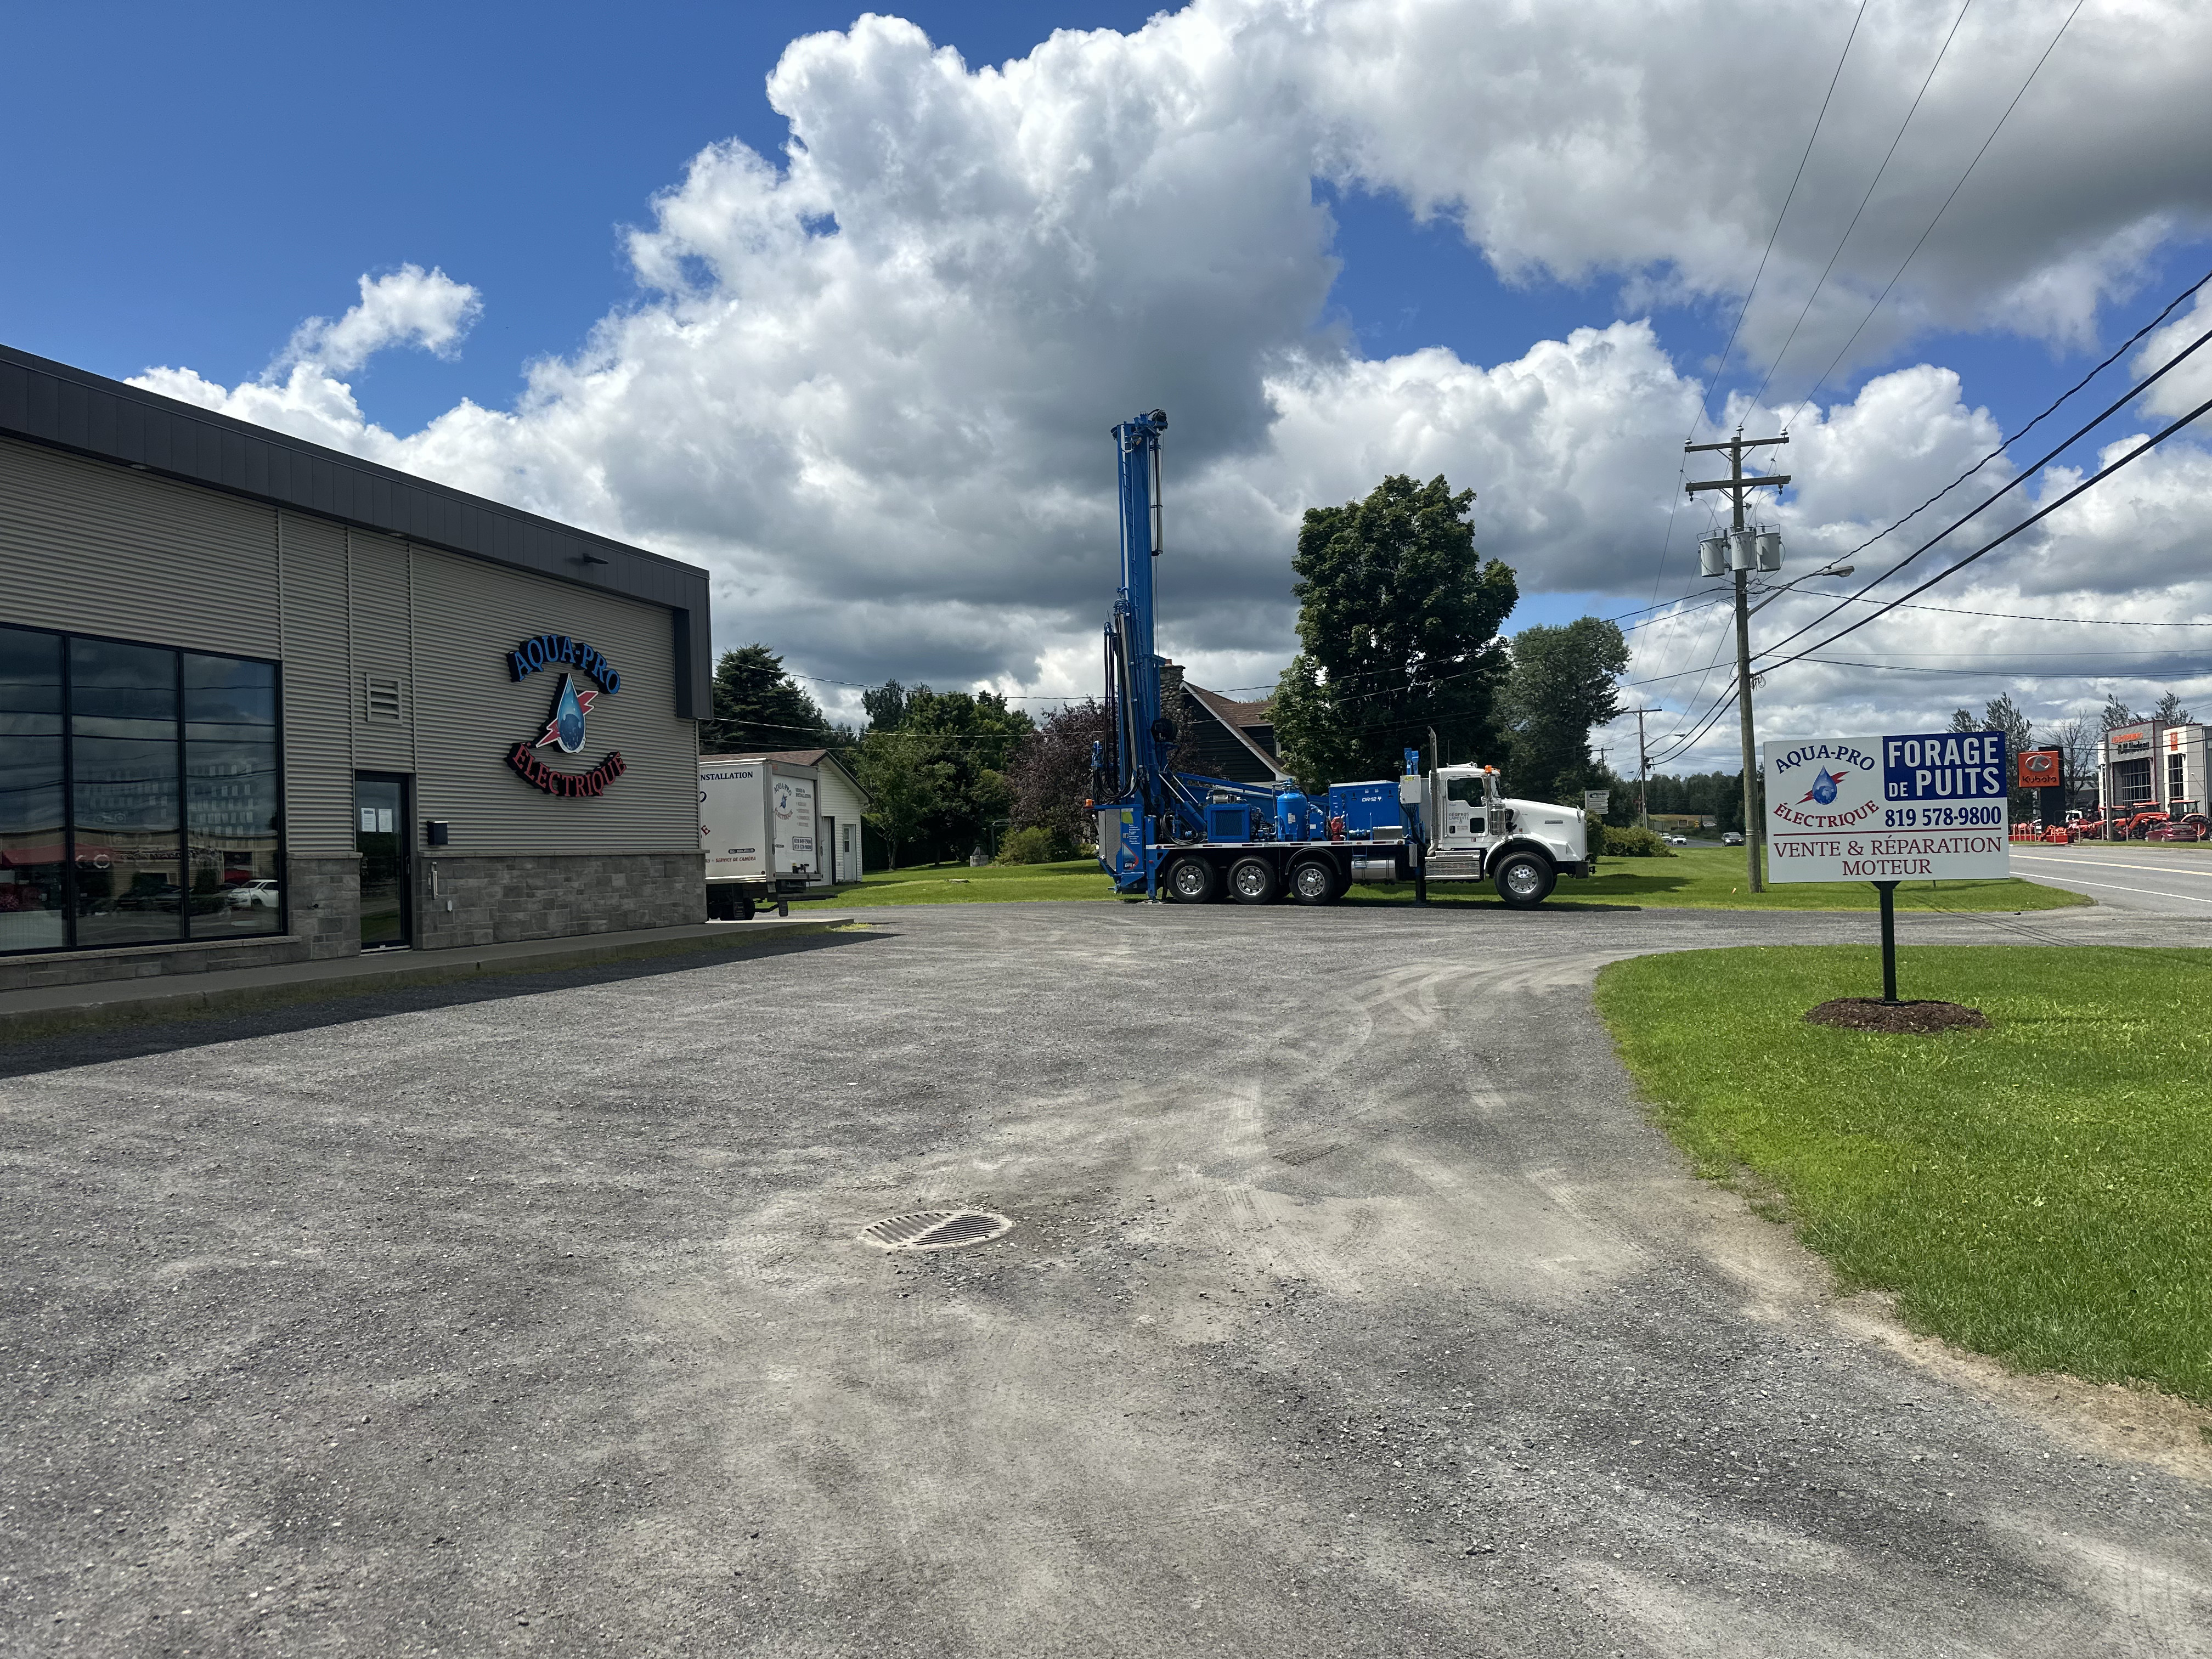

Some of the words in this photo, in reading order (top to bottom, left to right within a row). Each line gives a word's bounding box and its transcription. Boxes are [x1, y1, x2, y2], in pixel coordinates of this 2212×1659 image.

[513, 635, 620, 695] AQUA-PRO
[1775, 744, 1875, 774] AQUA-PRO
[1889, 737, 1999, 768] FORAGE
[700, 771, 753, 781] NSTALLATION
[1889, 782, 1908, 797] DE
[1916, 767, 2000, 796] PUITS
[1773, 800, 1880, 828] ÉLECTRIQUE
[1885, 809, 1916, 827] 819
[1922, 806, 2001, 826] 578-9800
[1774, 840, 1841, 857] VENTE
[1848, 840, 1864, 856] &
[1871, 835, 2002, 855] RÉPARATION
[1843, 859, 1932, 876] MOTEUR
